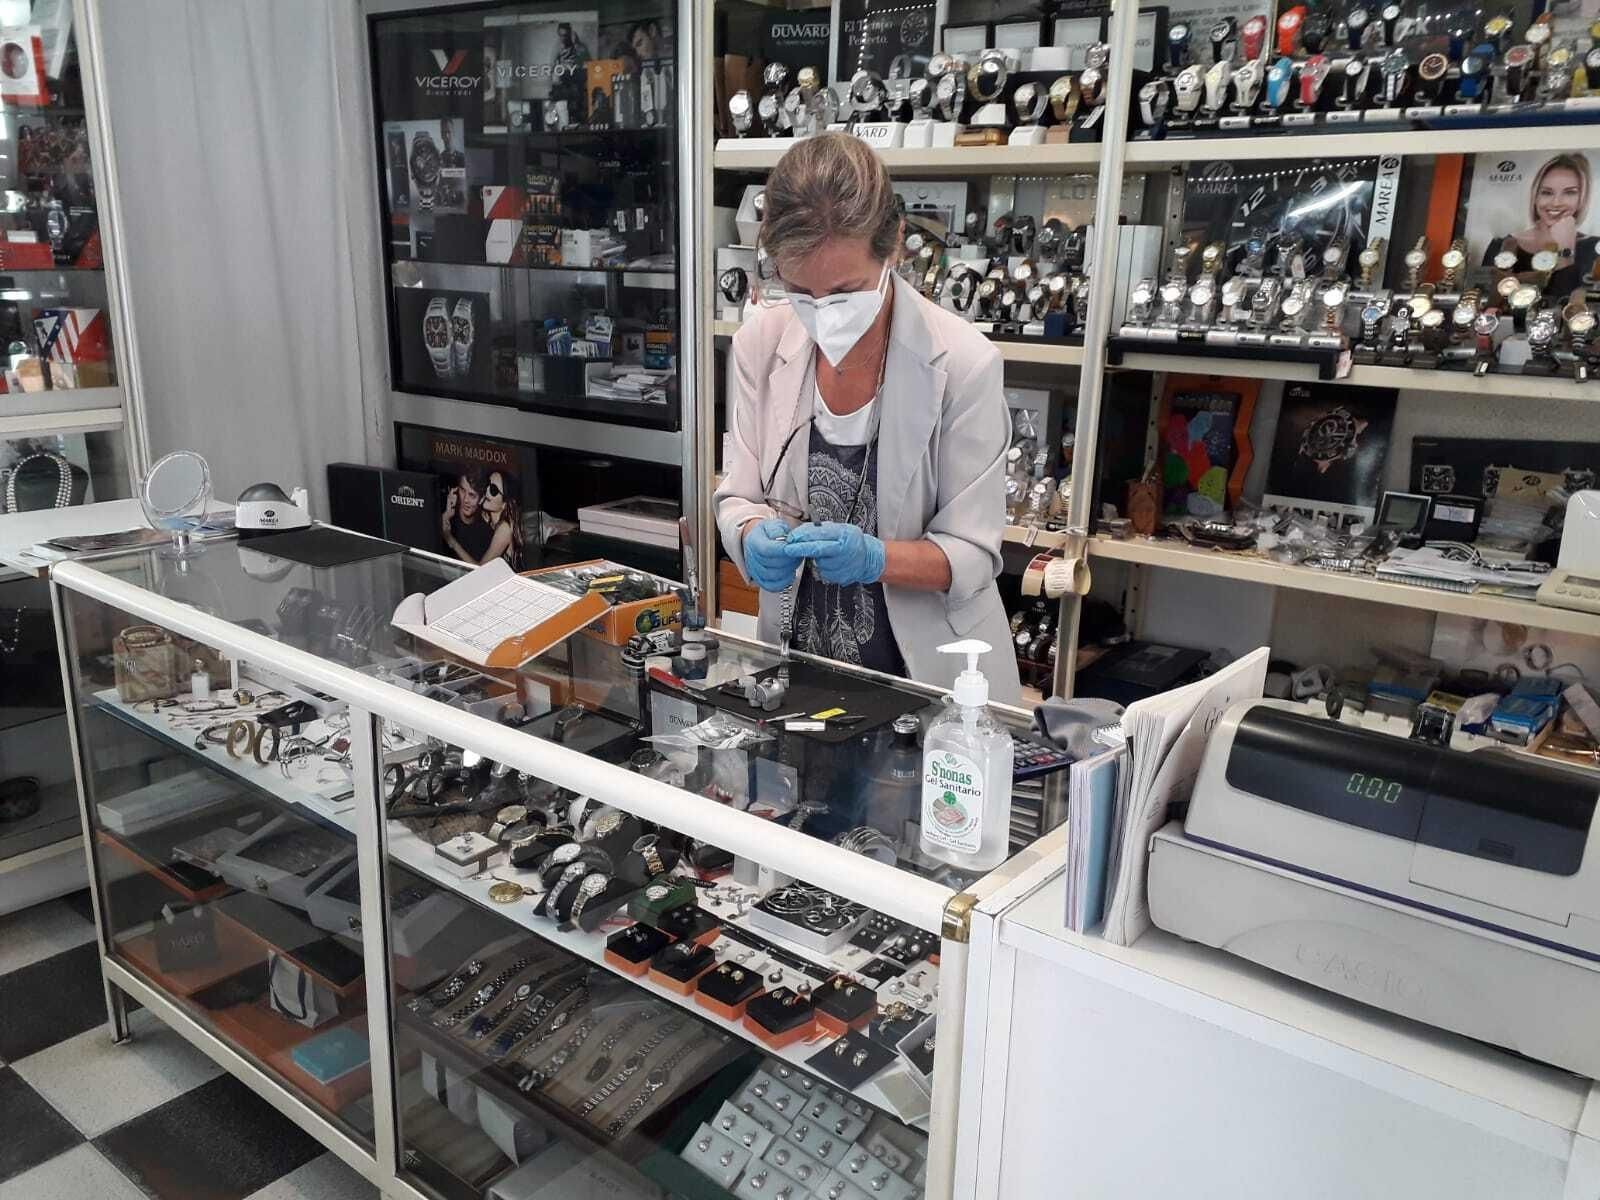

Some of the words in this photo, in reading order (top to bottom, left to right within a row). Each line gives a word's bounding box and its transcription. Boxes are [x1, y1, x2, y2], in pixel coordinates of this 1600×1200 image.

[771, 24, 831, 38] DUWARD
[415, 76, 481, 88] VICEROY
[496, 64, 578, 81] VICEROY
[1376, 171, 1395, 226] MAREA
[434, 441, 463, 457] MARK
[464, 446, 508, 464] MADDOX
[391, 495, 425, 508] ORIENT
[931, 760, 972, 785] S'nonas
[925, 774, 938, 786] Gel
[938, 779, 982, 798] Sanitario
[1346, 773, 1402, 804] 0.00
